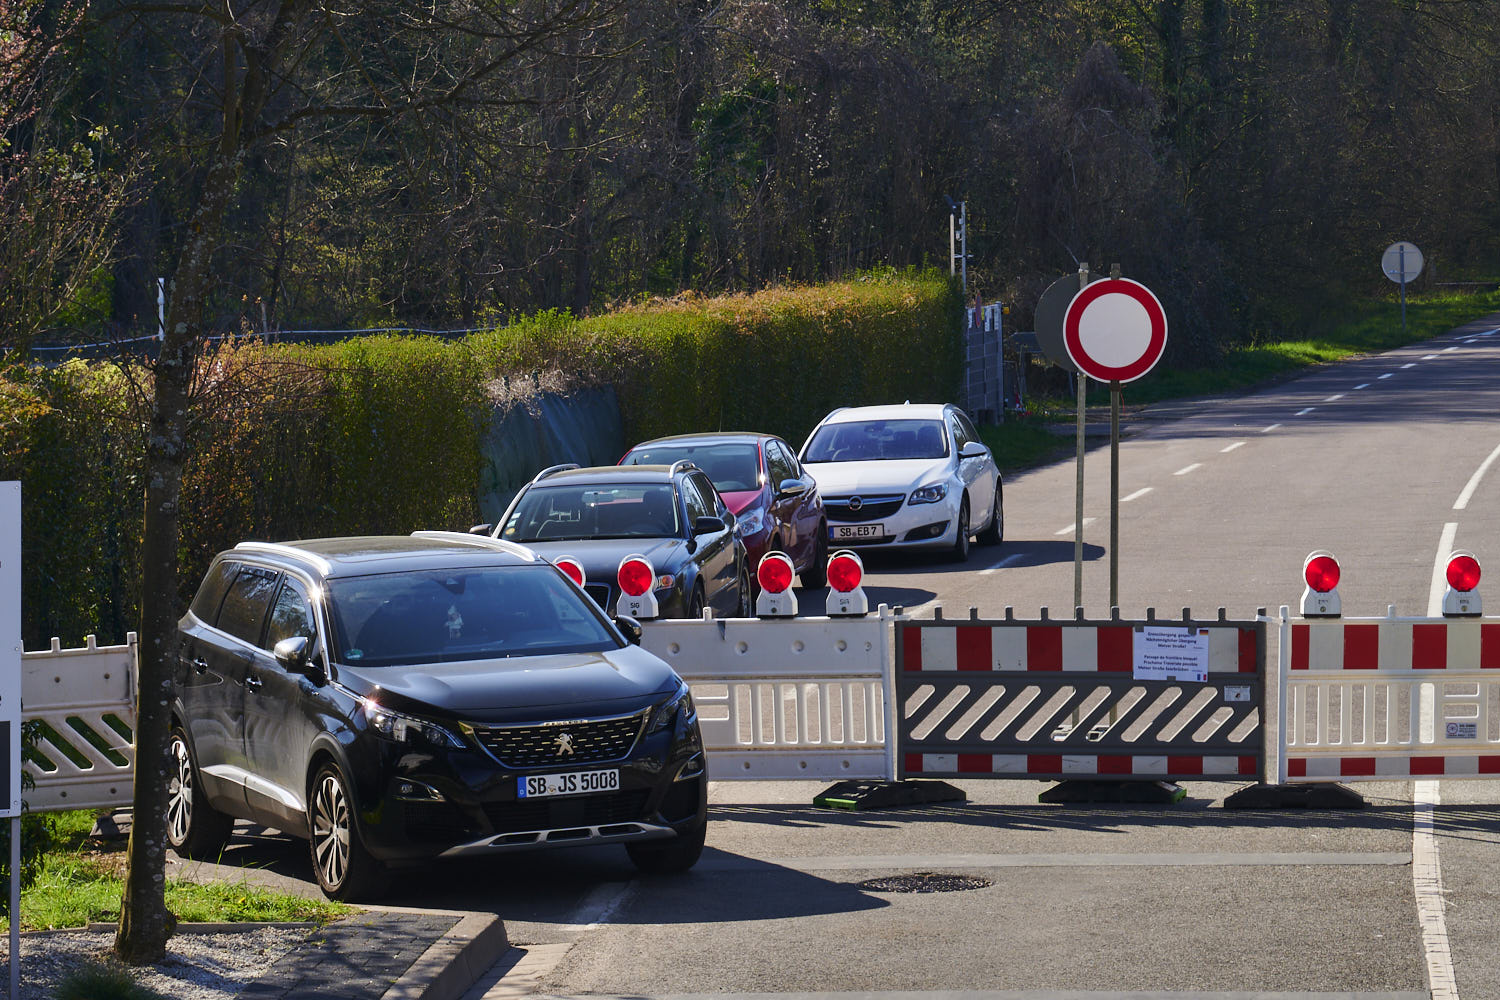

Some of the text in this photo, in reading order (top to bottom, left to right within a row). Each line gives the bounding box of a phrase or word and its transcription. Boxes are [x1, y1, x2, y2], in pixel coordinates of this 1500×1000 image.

[840, 528, 852, 537] SB
[857, 527, 869, 536] EB
[528, 777, 547, 795] SB
[558, 775, 577, 793] JS
[580, 771, 618, 791] 5008
